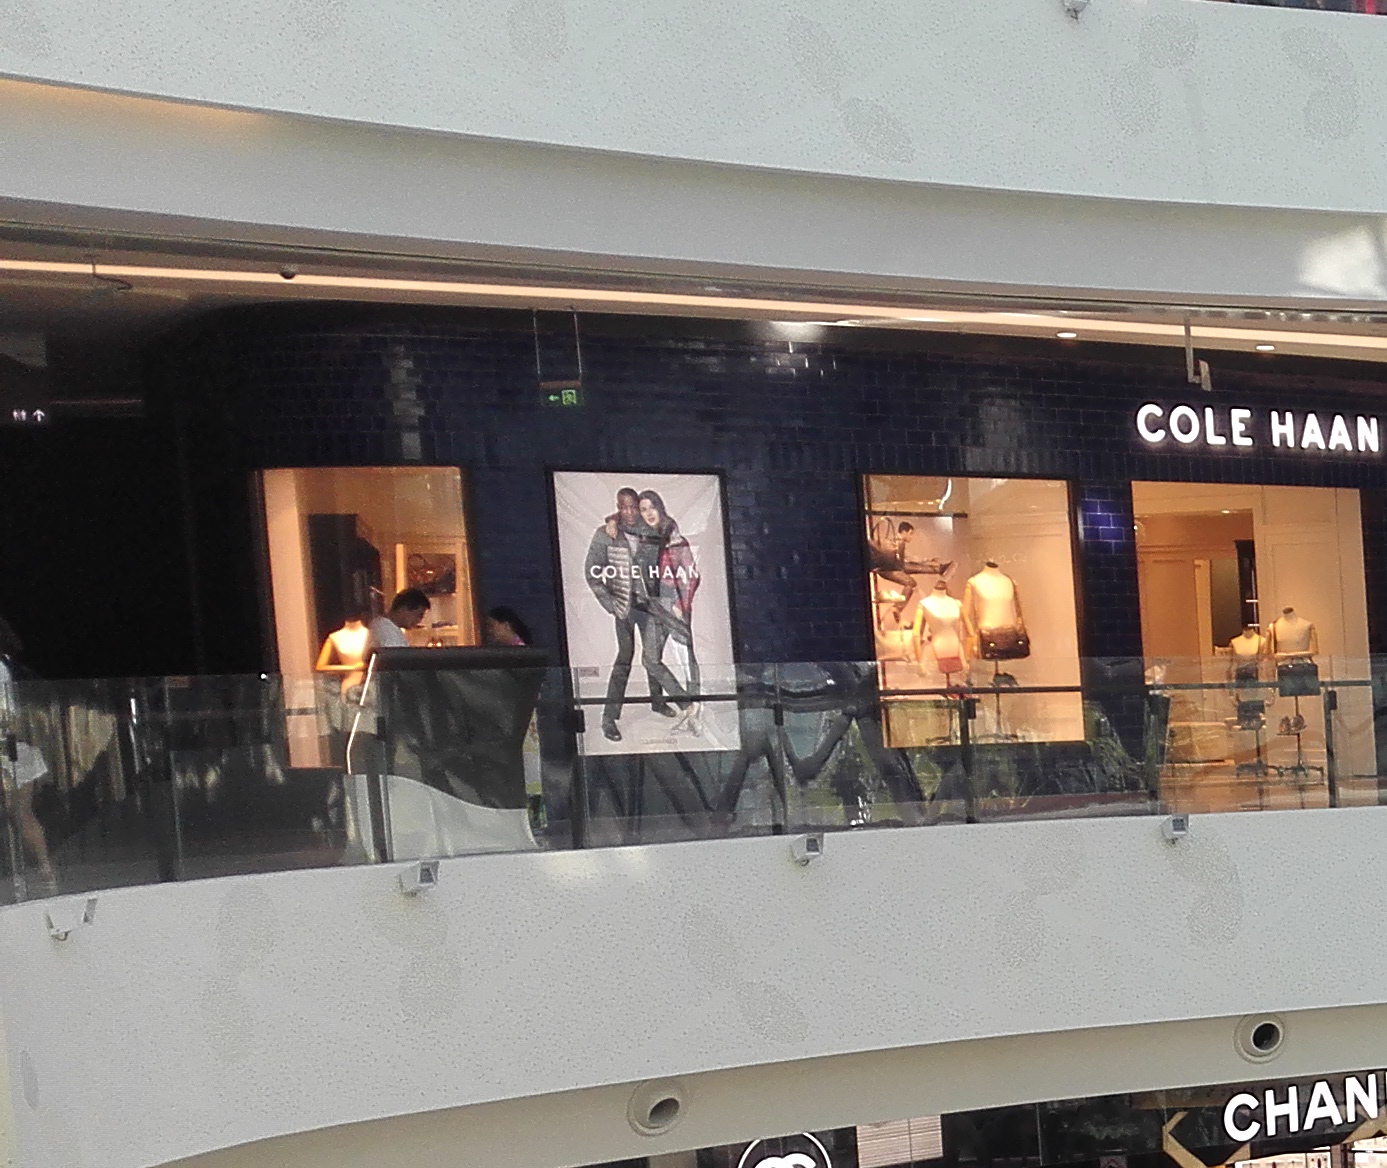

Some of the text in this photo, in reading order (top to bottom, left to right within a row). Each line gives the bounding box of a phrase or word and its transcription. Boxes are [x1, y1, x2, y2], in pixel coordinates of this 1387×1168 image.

[1136, 403, 1380, 452] COLE HAAN
[590, 565, 699, 579] COLE HAAN
